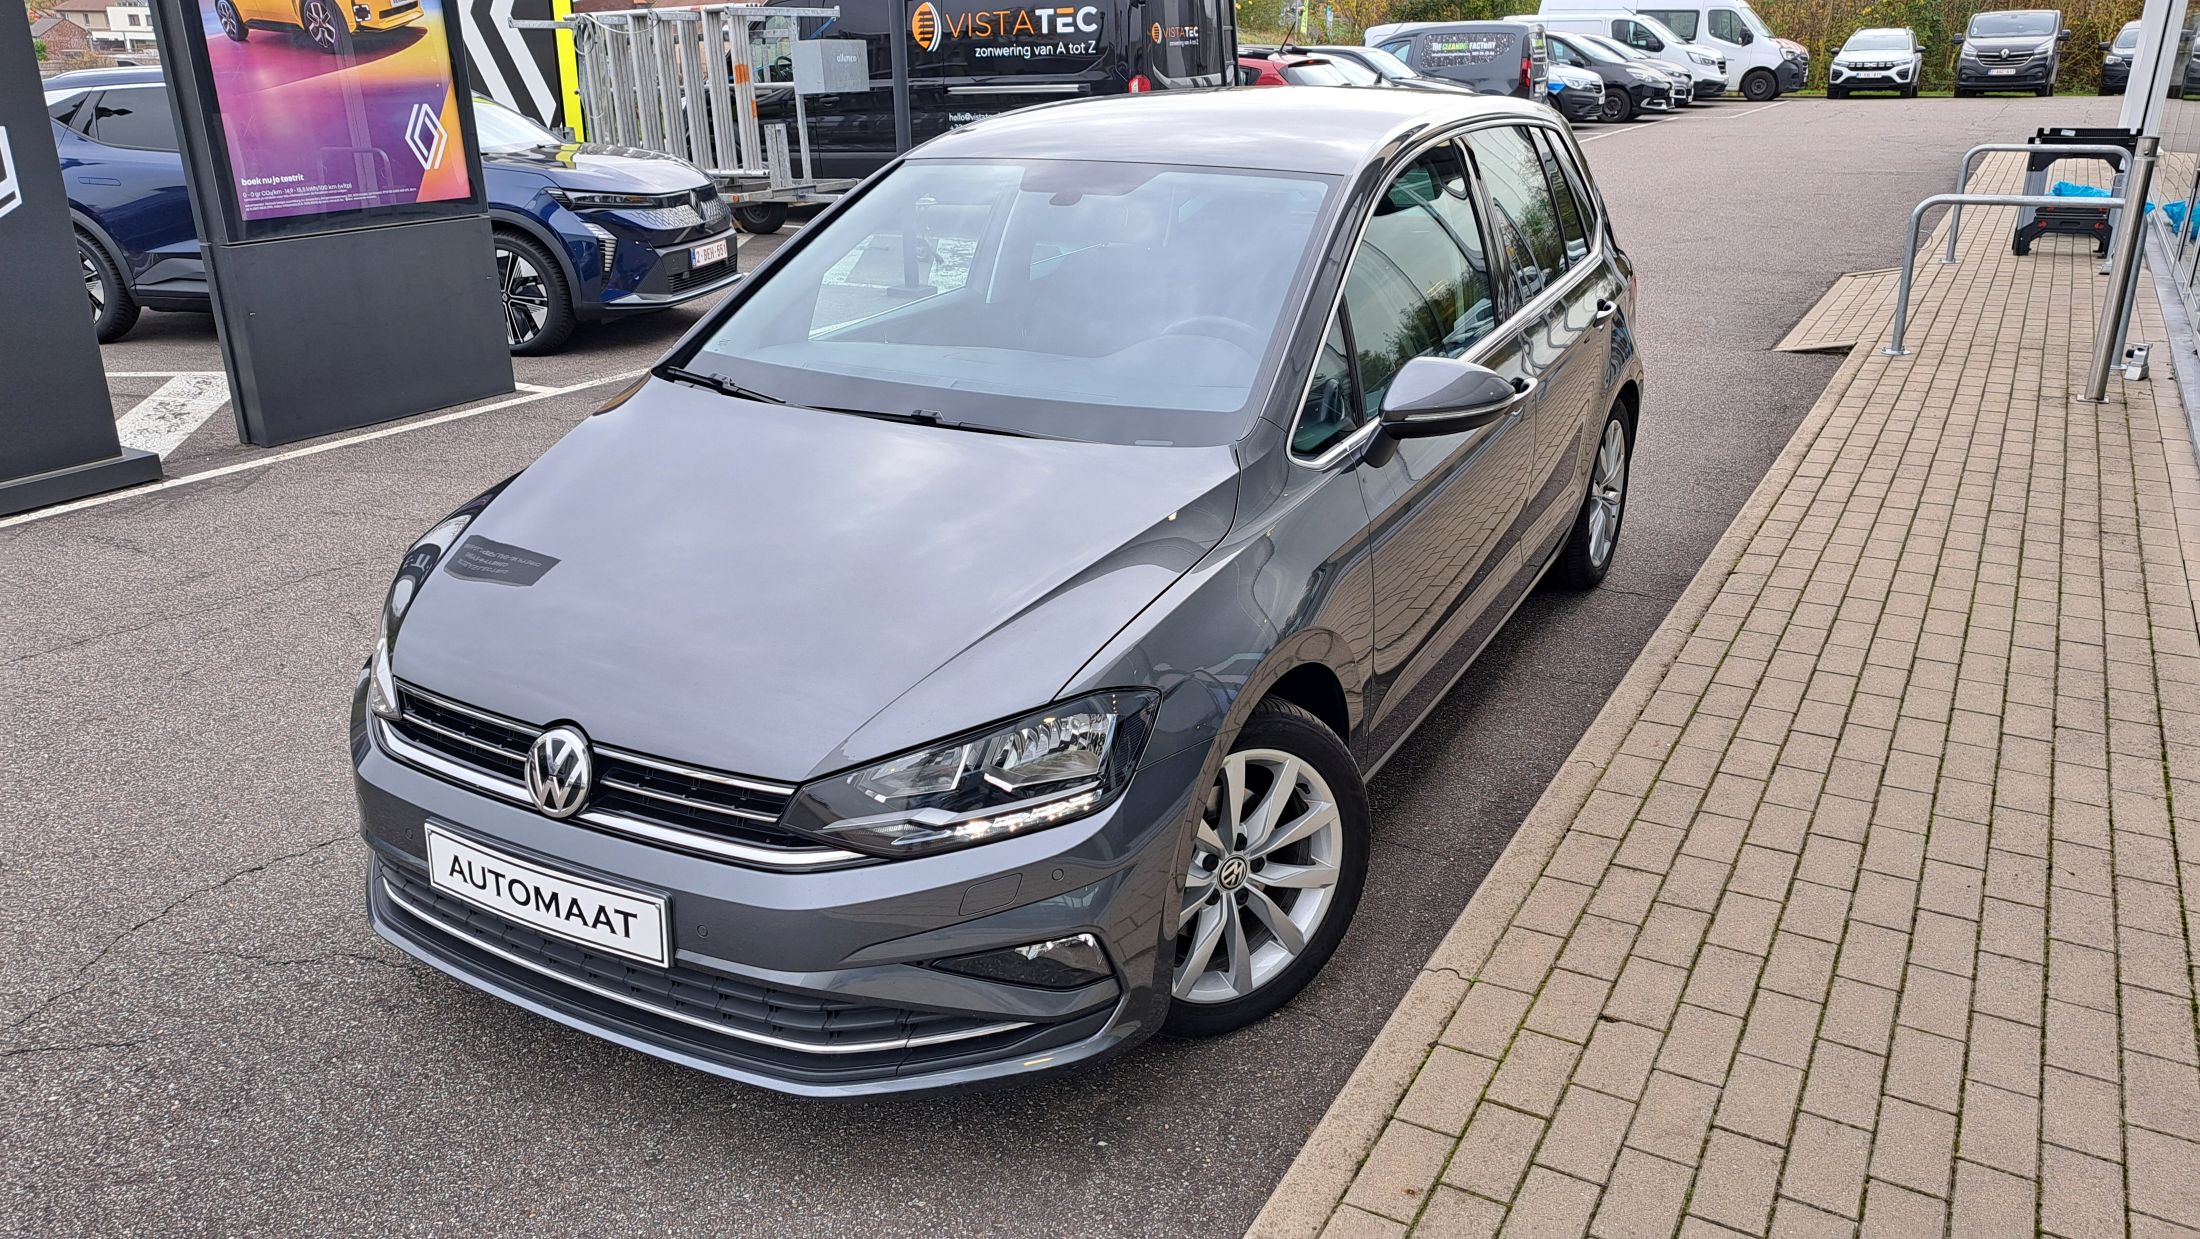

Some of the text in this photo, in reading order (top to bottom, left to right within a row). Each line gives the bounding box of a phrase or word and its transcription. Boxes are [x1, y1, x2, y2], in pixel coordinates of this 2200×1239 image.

[945, 6, 1098, 38] VISTATEC
[1162, 26, 1199, 38] VISTATEC
[974, 41, 1097, 59] zonwering van A tot Z
[262, 177, 272, 185] nu
[280, 173, 305, 183] testrit
[449, 854, 638, 939] AUTOMAAT
